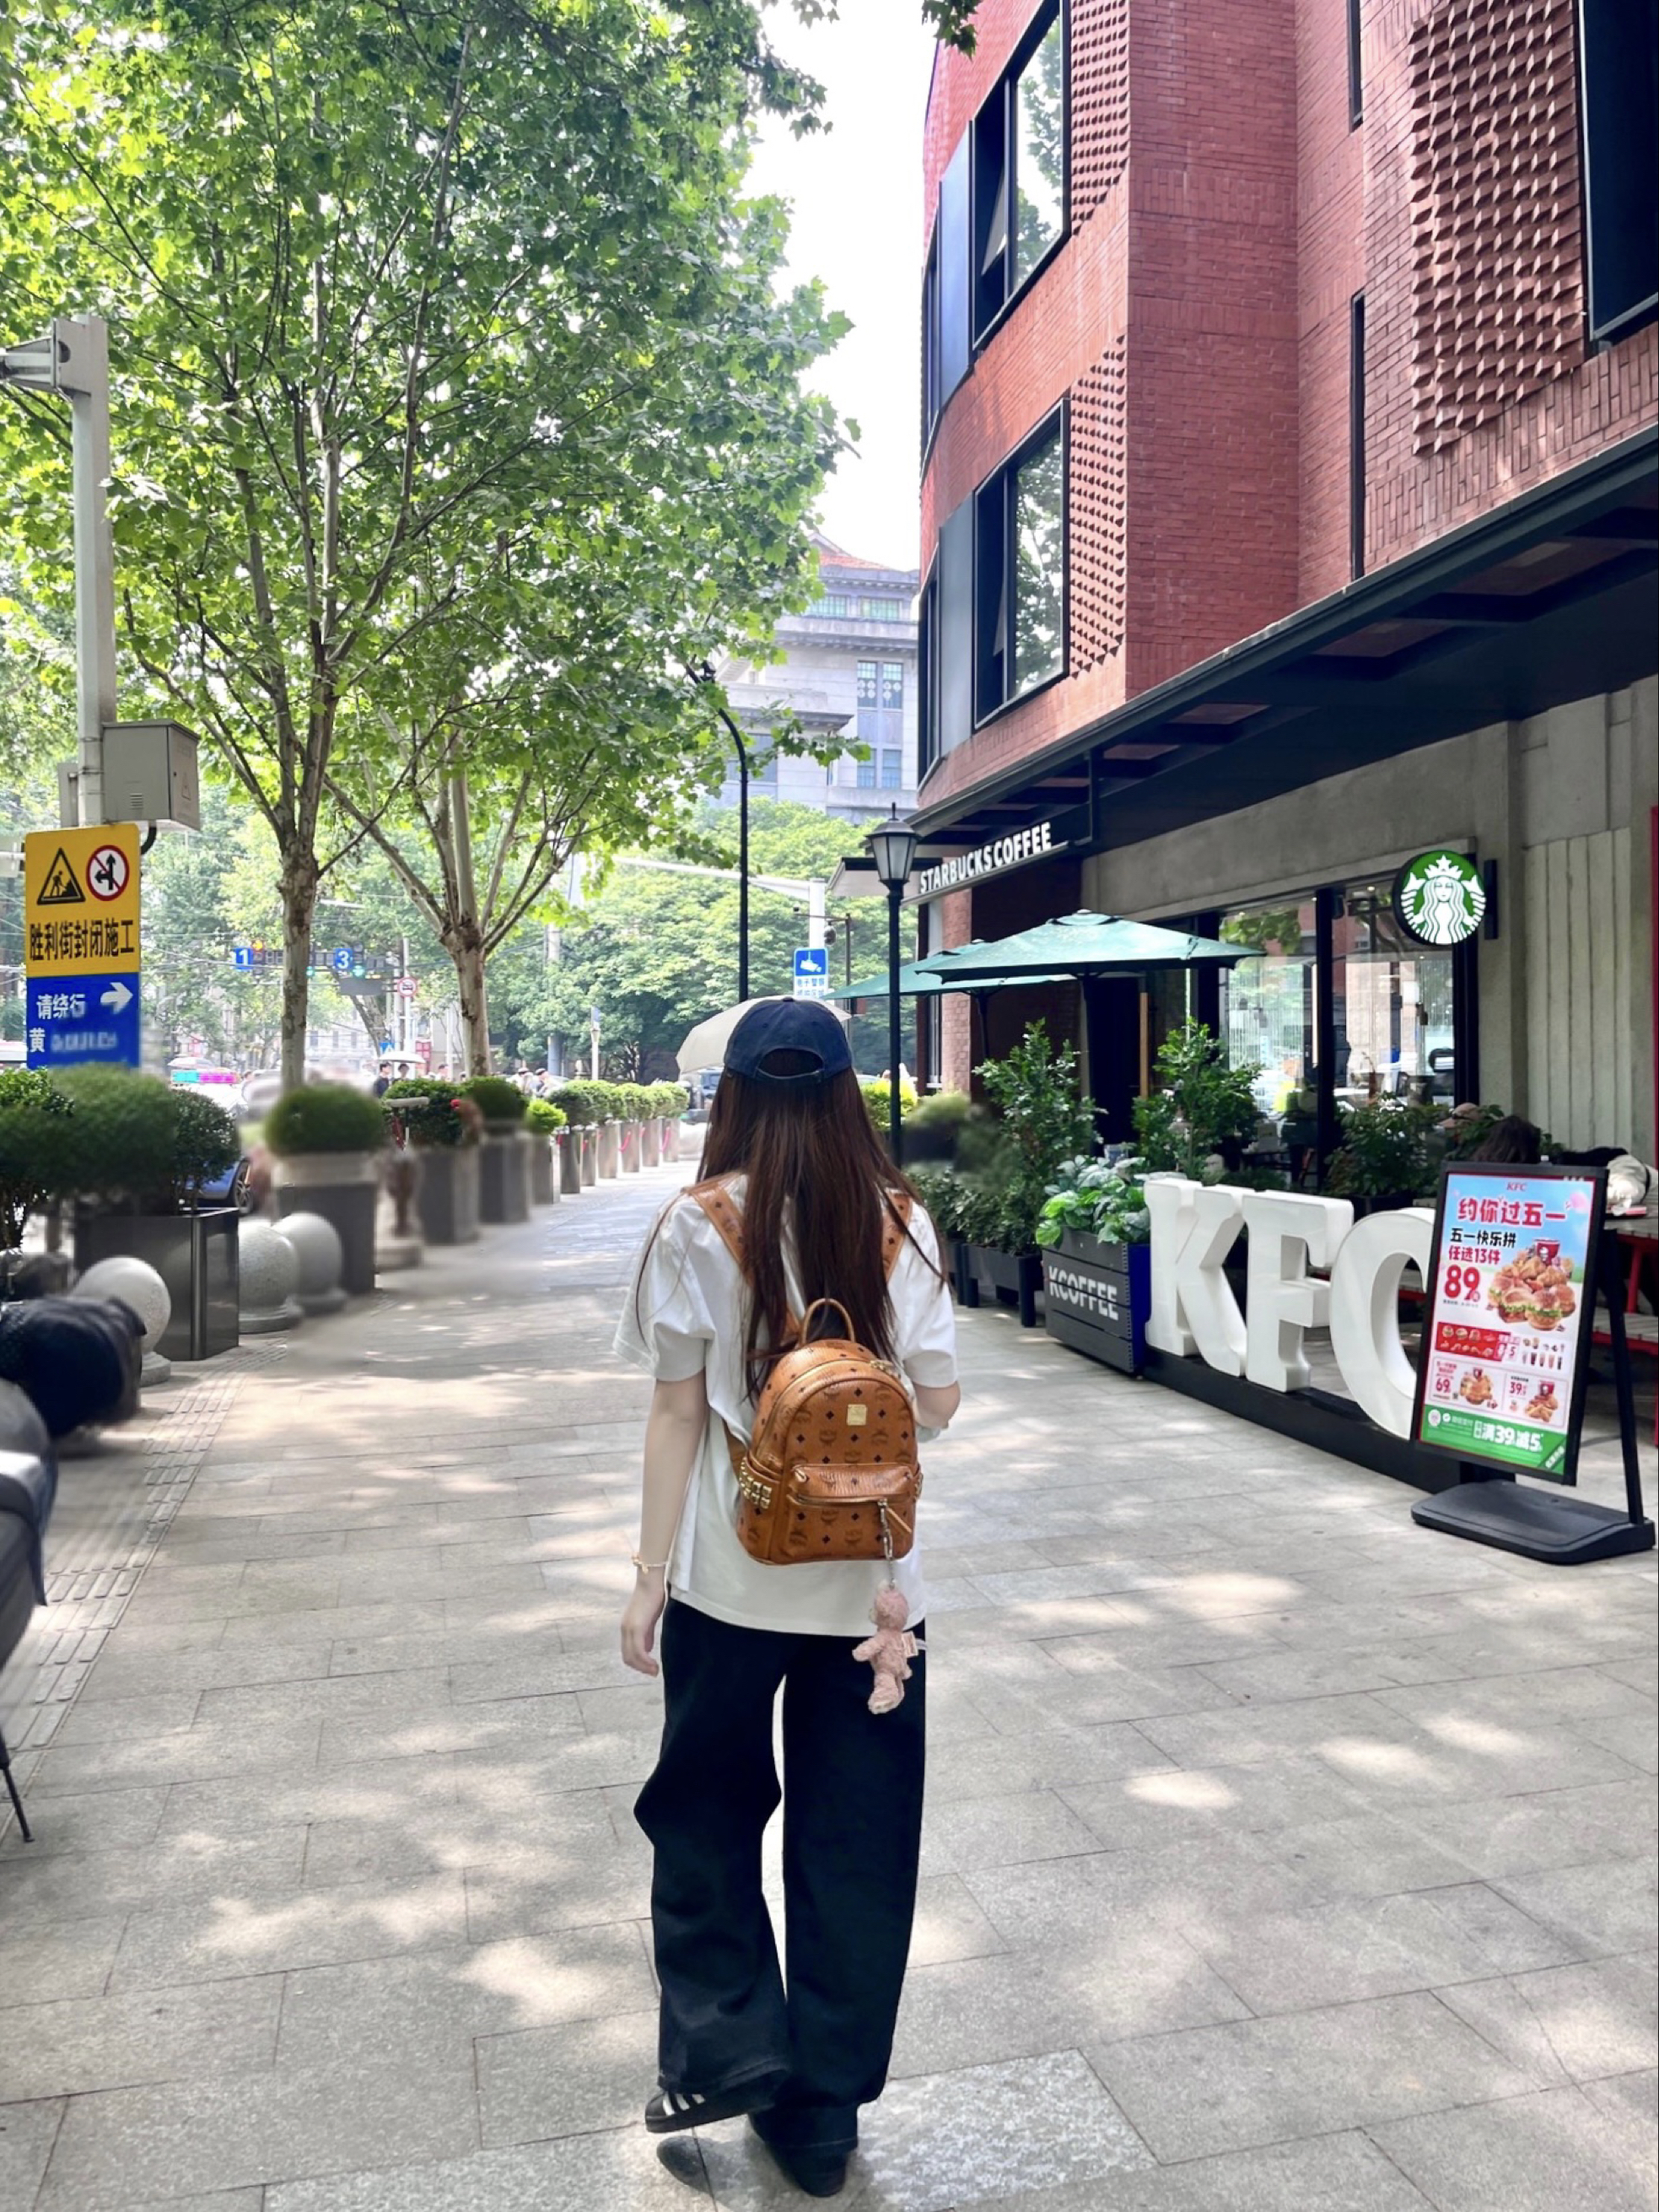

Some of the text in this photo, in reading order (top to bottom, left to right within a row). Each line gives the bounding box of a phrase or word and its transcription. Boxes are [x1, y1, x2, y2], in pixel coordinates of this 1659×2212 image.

[919, 821, 1053, 894] STARBUCKS COFFEE
[30, 918, 135, 961] 胜利街封闭施工
[239, 948, 249, 966] 1
[337, 950, 349, 969] 3
[36, 993, 86, 1020] 请绕行
[1506, 1182, 1527, 1191] KFC
[1457, 1198, 1566, 1227] 约你过五一
[1450, 1227, 1516, 1249] 五一快乐拼
[1448, 1244, 1501, 1265] 任选13件
[1048, 1265, 1119, 1321] KCOFFEE
[1443, 1265, 1480, 1302] 89
[1145, 1179, 1435, 1441] KFC
